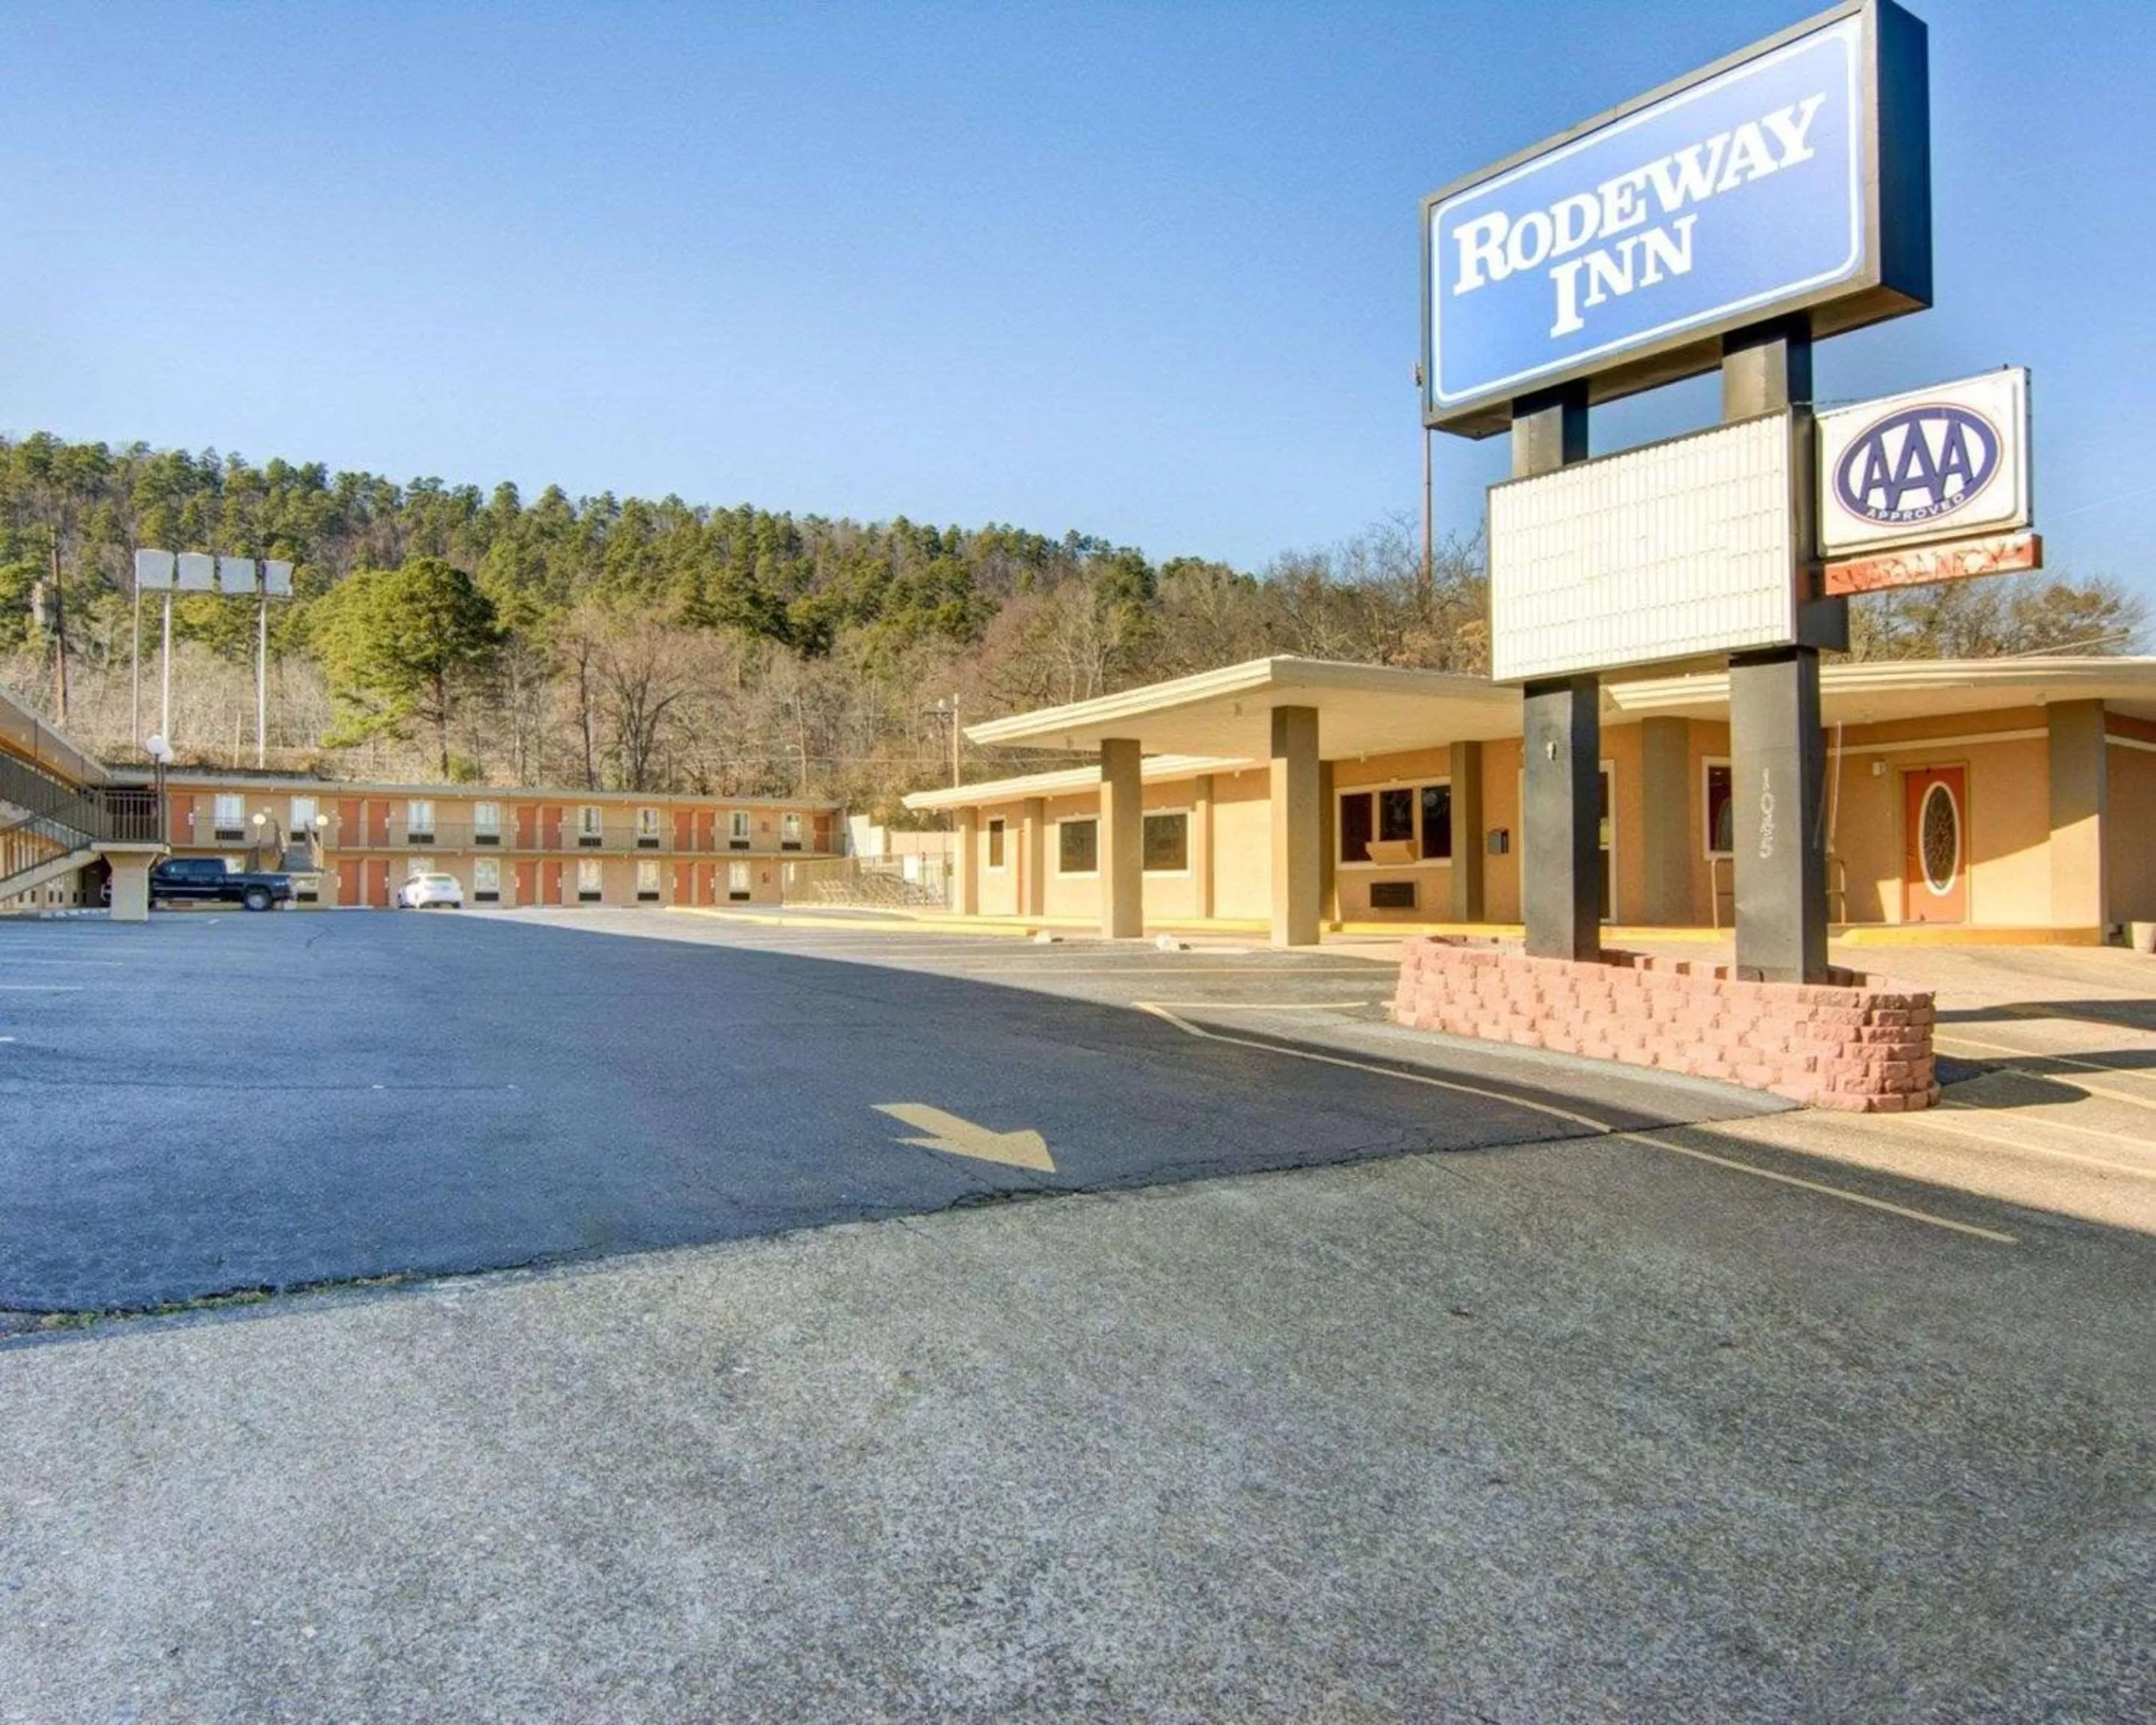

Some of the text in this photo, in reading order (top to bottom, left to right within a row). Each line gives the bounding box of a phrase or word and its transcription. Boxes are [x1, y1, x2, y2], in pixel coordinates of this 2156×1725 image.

[1452, 92, 1827, 296] RODEWAY
[1549, 214, 1698, 339] INN
[1858, 416, 1974, 511] AAA
[1866, 492, 1967, 521] APPROVED
